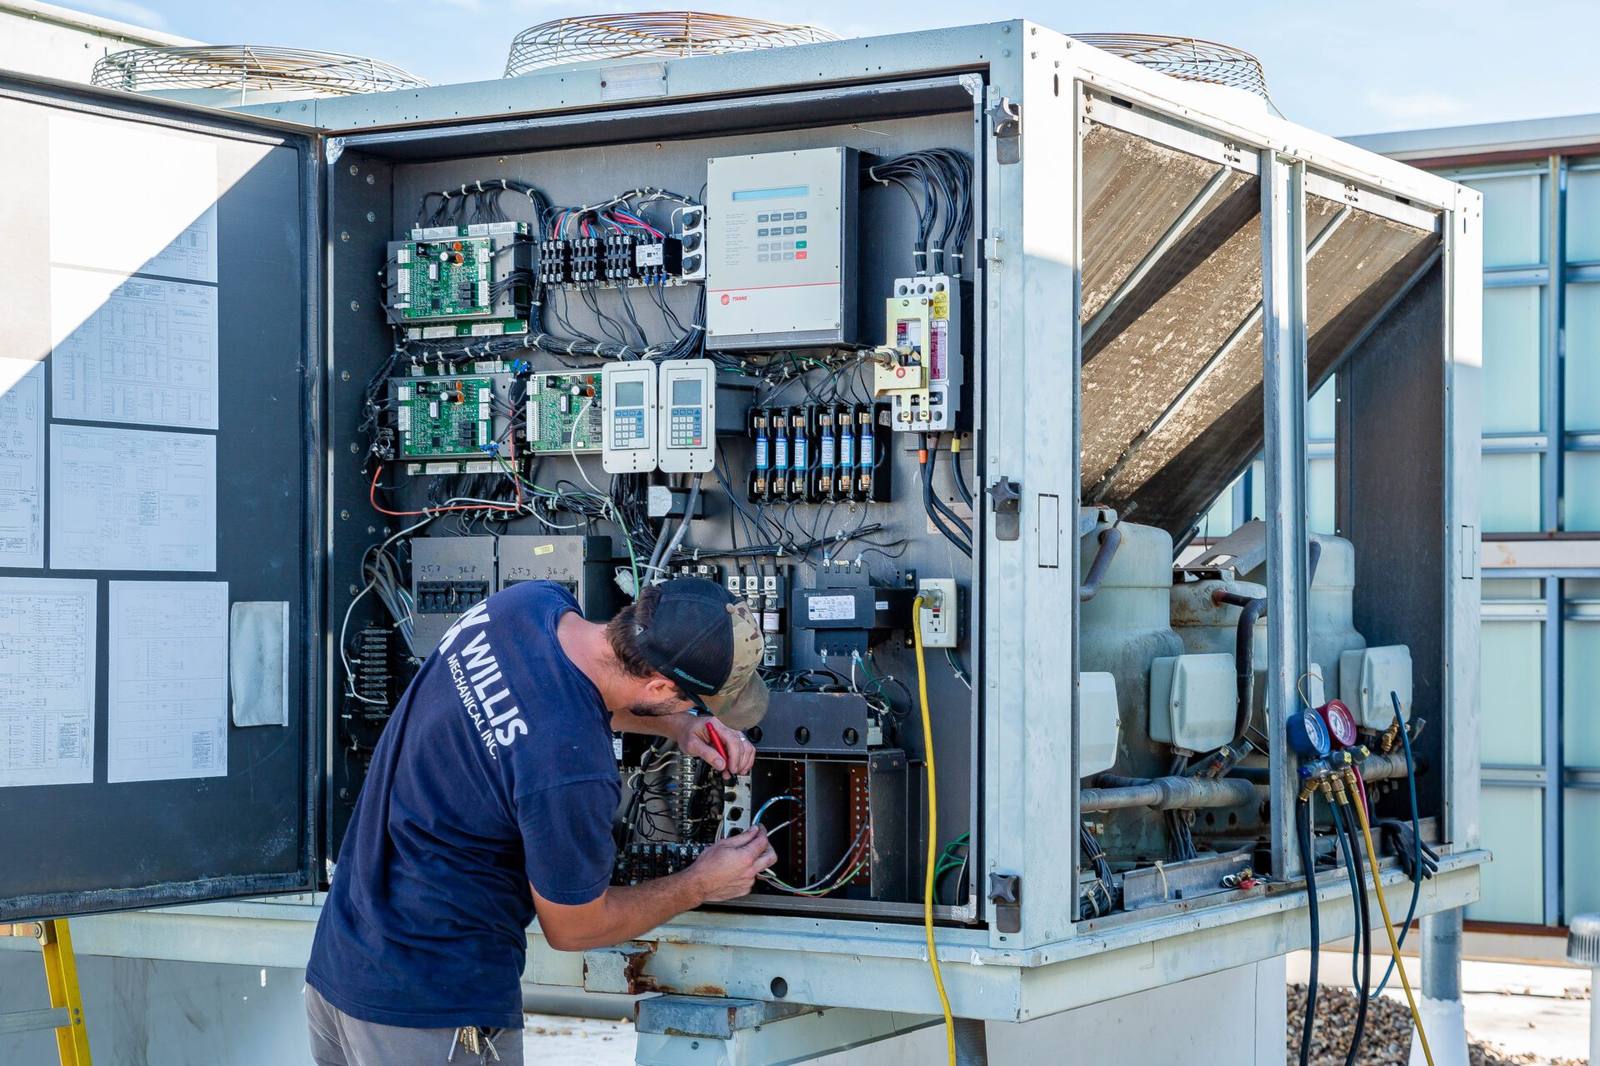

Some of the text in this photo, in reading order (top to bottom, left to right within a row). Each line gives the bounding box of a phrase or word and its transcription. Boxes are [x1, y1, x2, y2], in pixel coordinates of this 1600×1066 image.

[447, 653, 498, 760] MECHANICAL INC.
[461, 630, 528, 746] WILLIS
